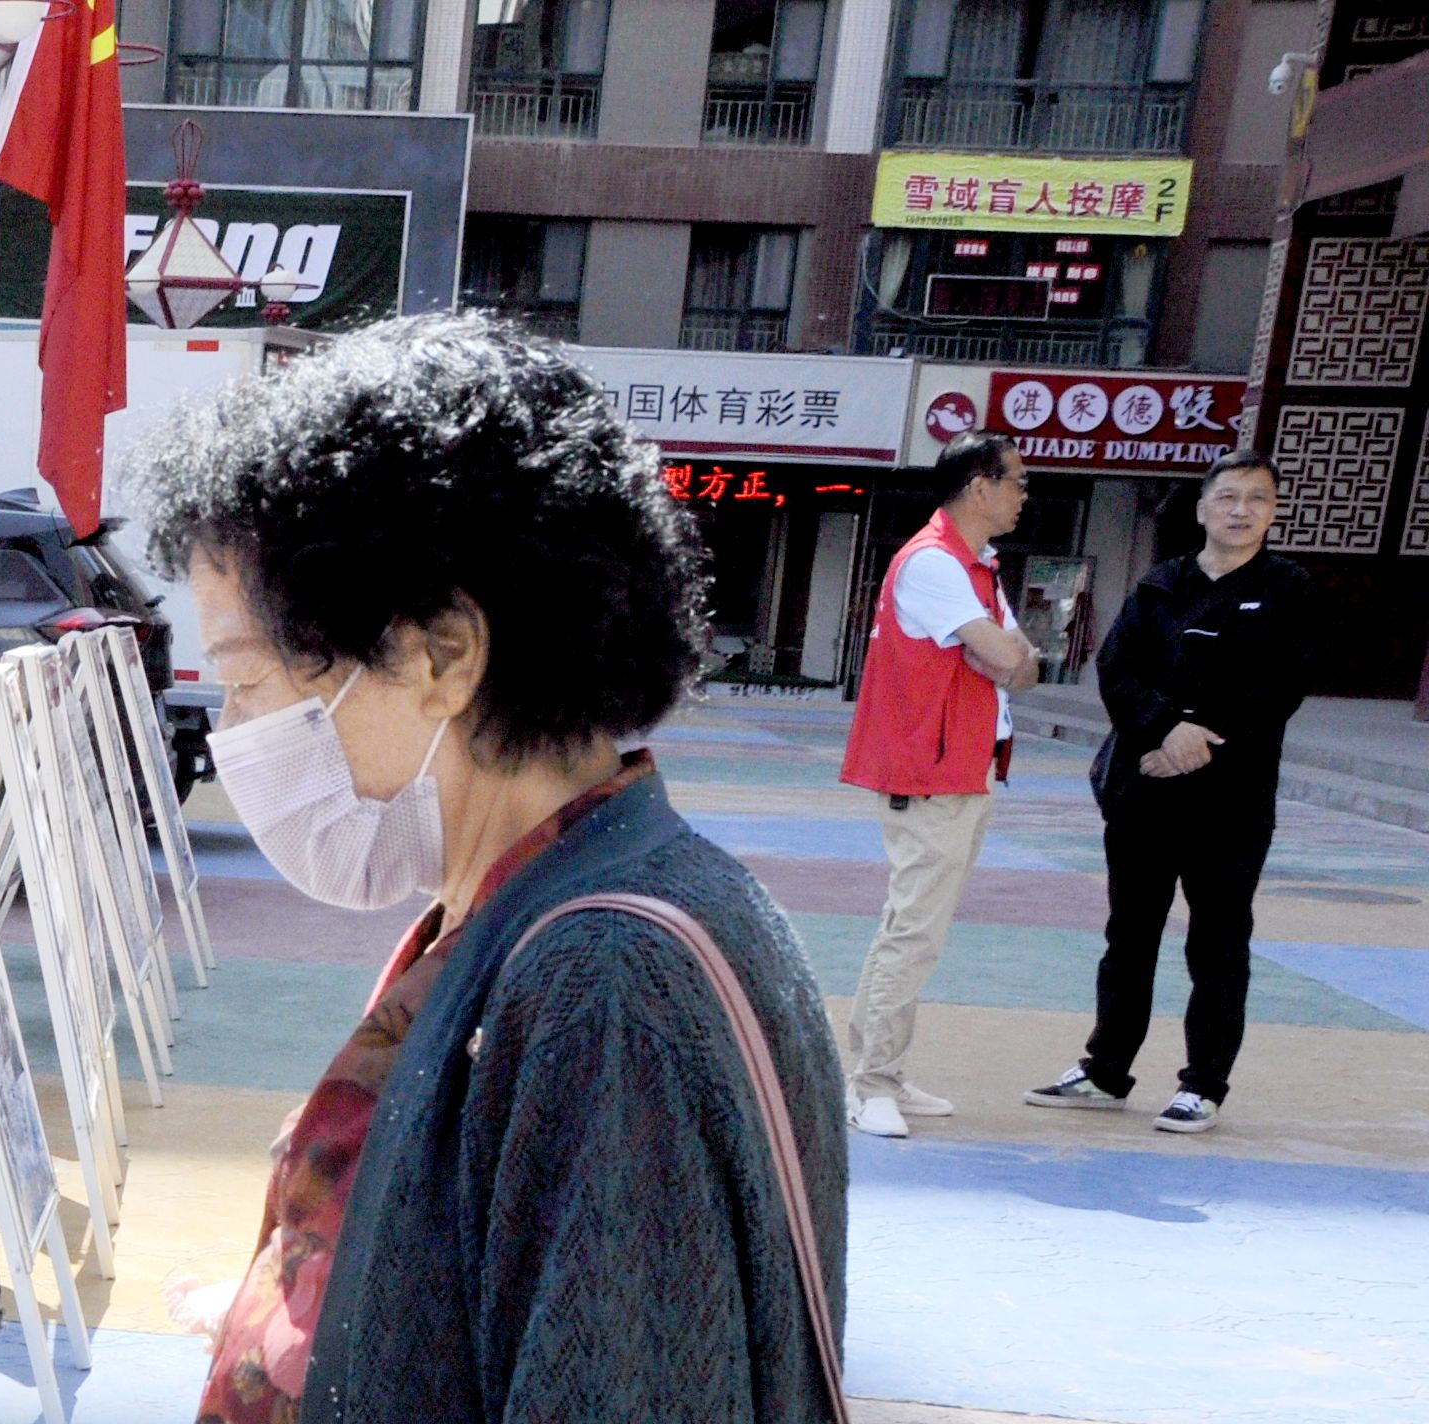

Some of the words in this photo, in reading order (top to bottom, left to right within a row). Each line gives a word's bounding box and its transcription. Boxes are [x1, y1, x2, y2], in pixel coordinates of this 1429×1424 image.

[905, 175, 1145, 217] 雪域盲人按摩
[124, 214, 341, 302] Fng
